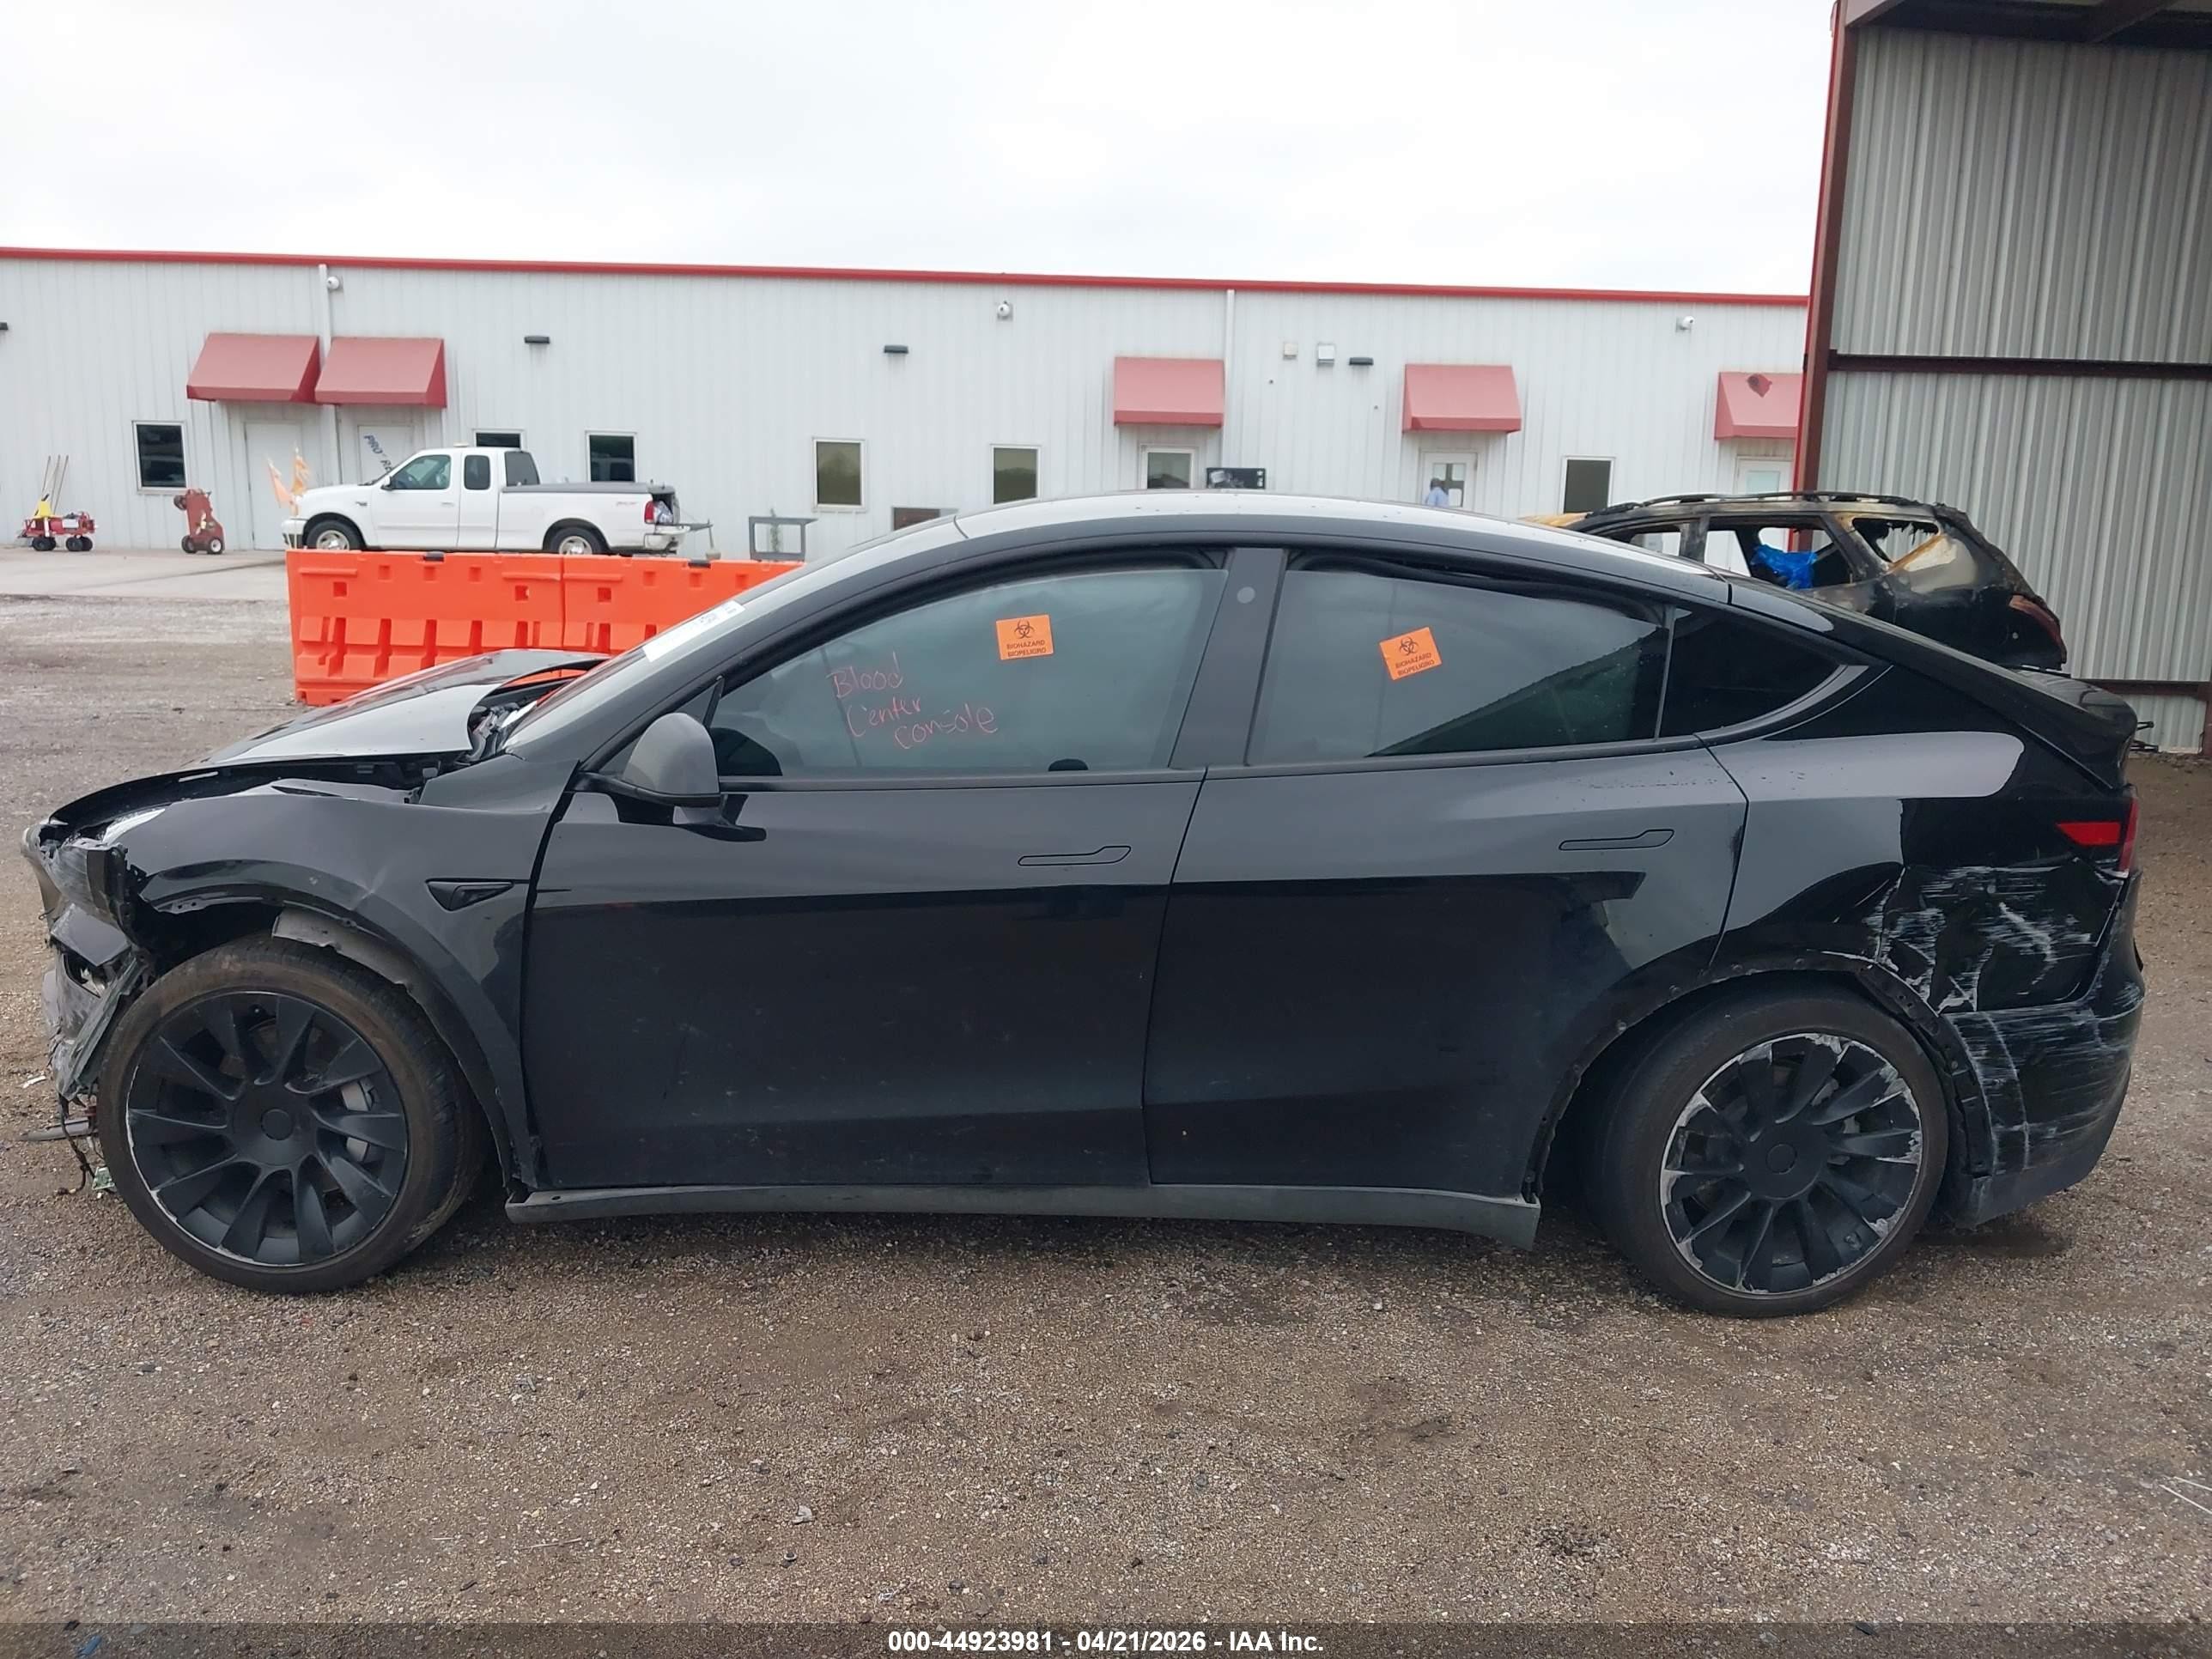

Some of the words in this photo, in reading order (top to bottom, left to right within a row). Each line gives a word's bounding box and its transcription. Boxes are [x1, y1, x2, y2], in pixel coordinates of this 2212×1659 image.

[1006, 640, 1046, 650] BIOHAZARD
[1007, 647, 1047, 658] BIOPELIGRO
[1395, 653, 1431, 668] BIOHAZARD
[826, 651, 903, 698] Blood
[847, 696, 921, 737] Center
